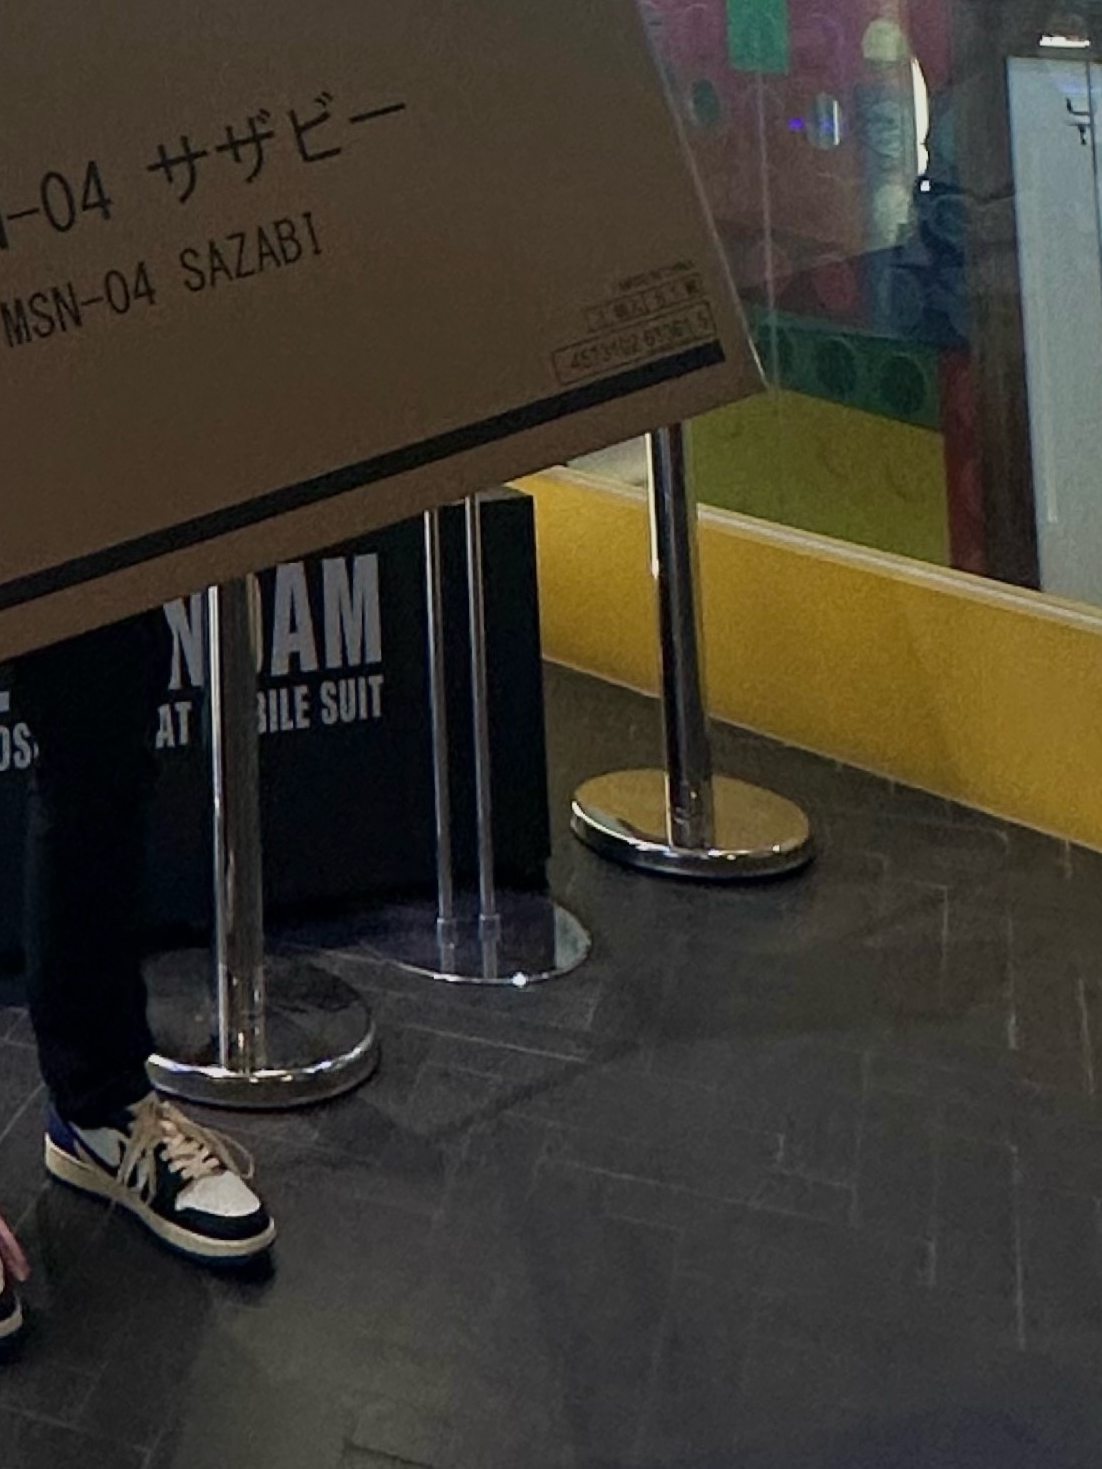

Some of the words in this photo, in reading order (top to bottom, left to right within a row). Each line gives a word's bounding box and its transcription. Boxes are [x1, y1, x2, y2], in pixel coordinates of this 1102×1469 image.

[146, 90, 407, 205] サザビー
[0, 261, 156, 348] MSN-04
[180, 211, 323, 292] SAZABI
[163, 553, 382, 690] NAM
[156, 701, 192, 749] AT
[319, 675, 384, 725] SUIT
